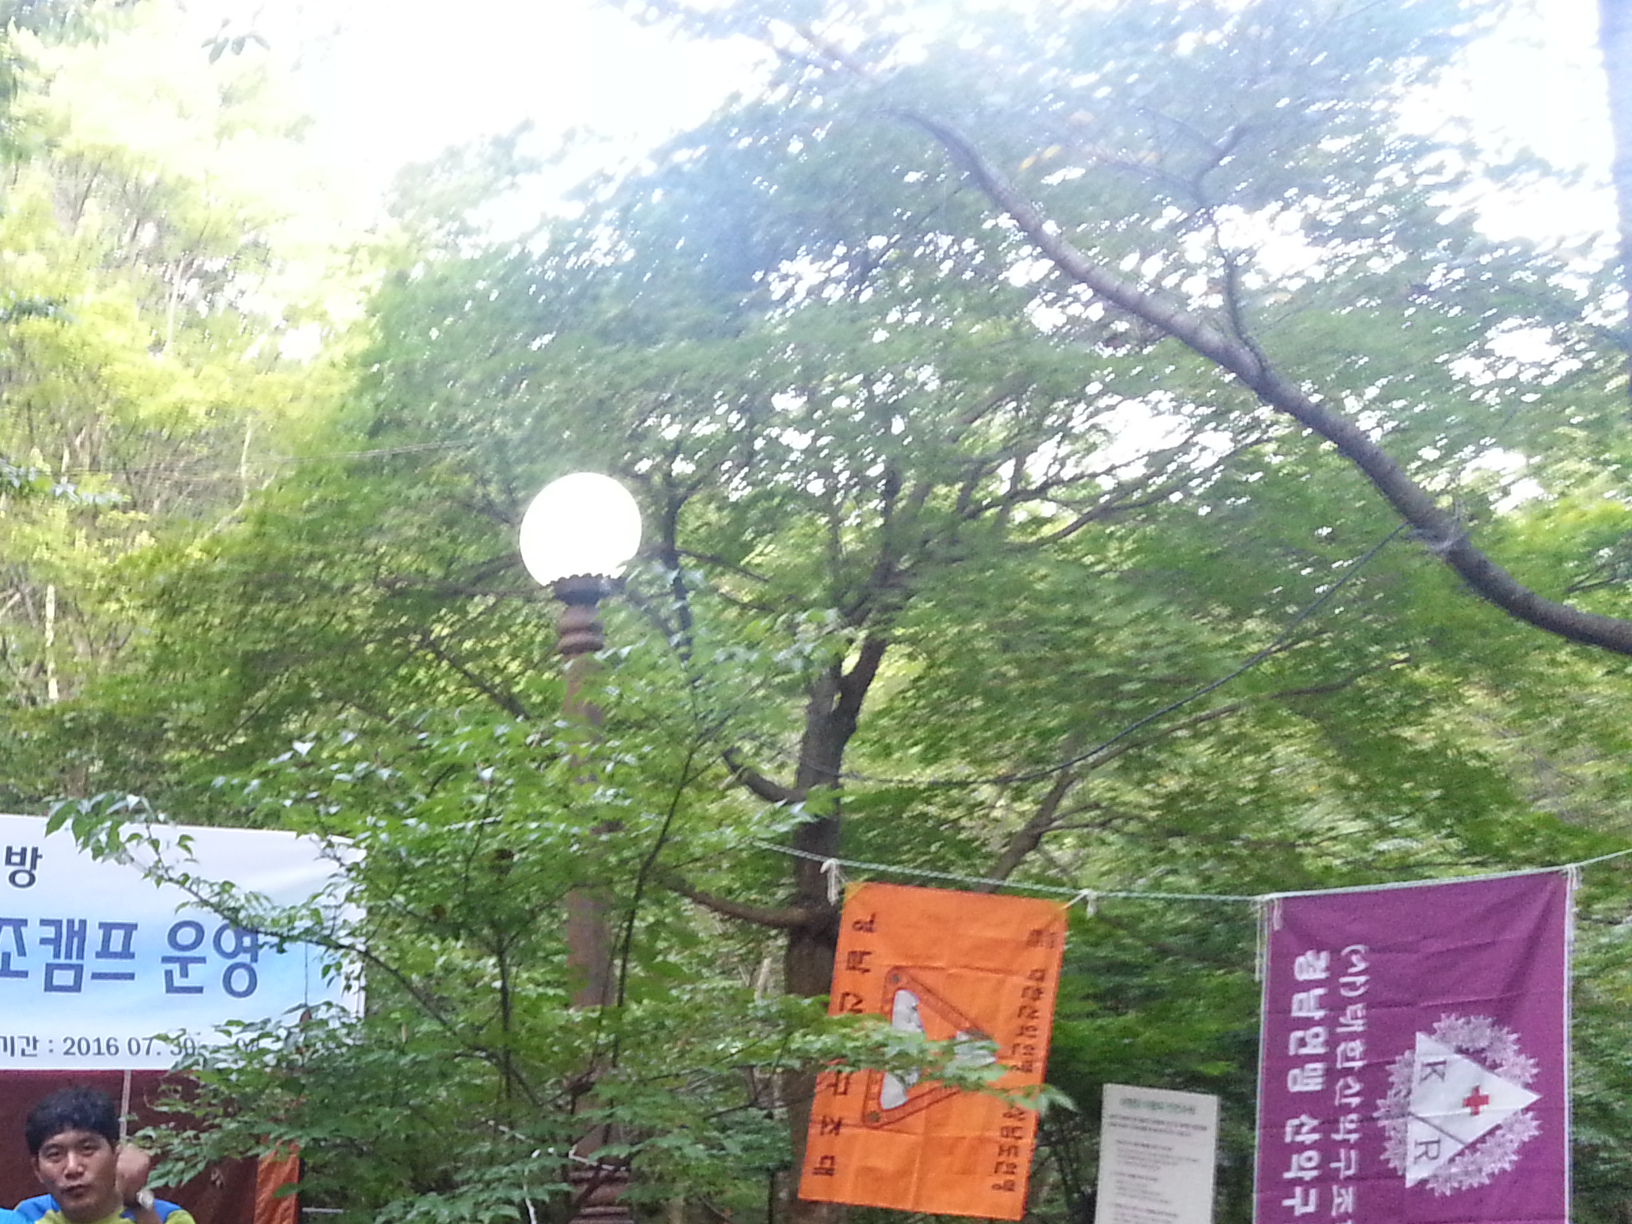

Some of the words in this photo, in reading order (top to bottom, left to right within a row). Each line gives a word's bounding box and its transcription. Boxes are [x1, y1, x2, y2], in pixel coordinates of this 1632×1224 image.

[161, 919, 260, 998] 운영
[62, 1036, 120, 1056] 2016
[811, 914, 877, 1177] 경남산구조대
[1287, 949, 1331, 1092] 경남연맹
[1421, 1058, 1447, 1083] K
[1414, 1137, 1442, 1164] R
